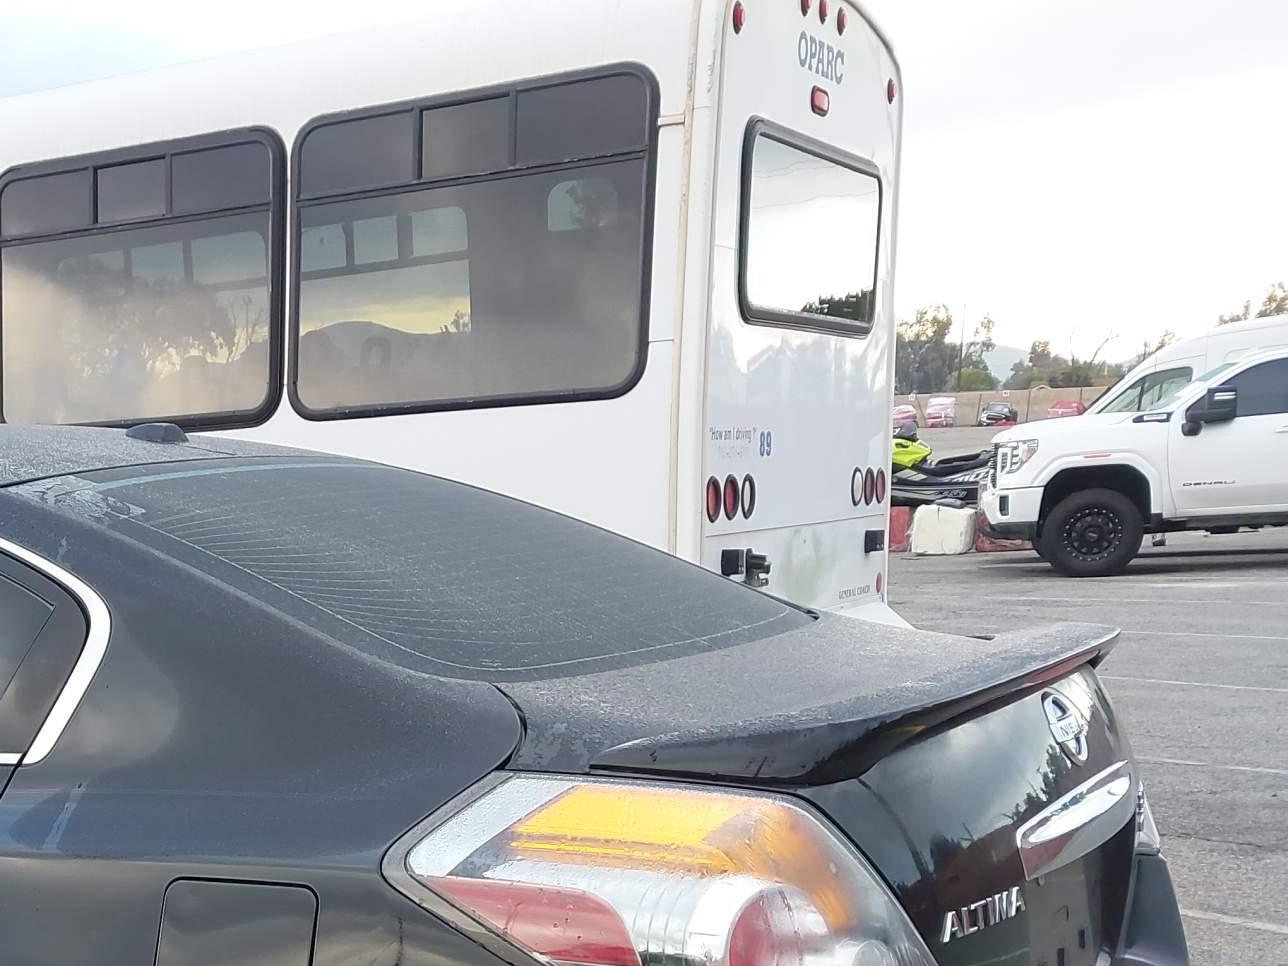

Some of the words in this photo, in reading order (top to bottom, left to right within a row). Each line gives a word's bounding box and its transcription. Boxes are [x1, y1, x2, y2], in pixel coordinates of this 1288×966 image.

[798, 30, 845, 85] OPARC
[759, 431, 772, 456] 89
[940, 886, 1026, 943] ALTIMA
